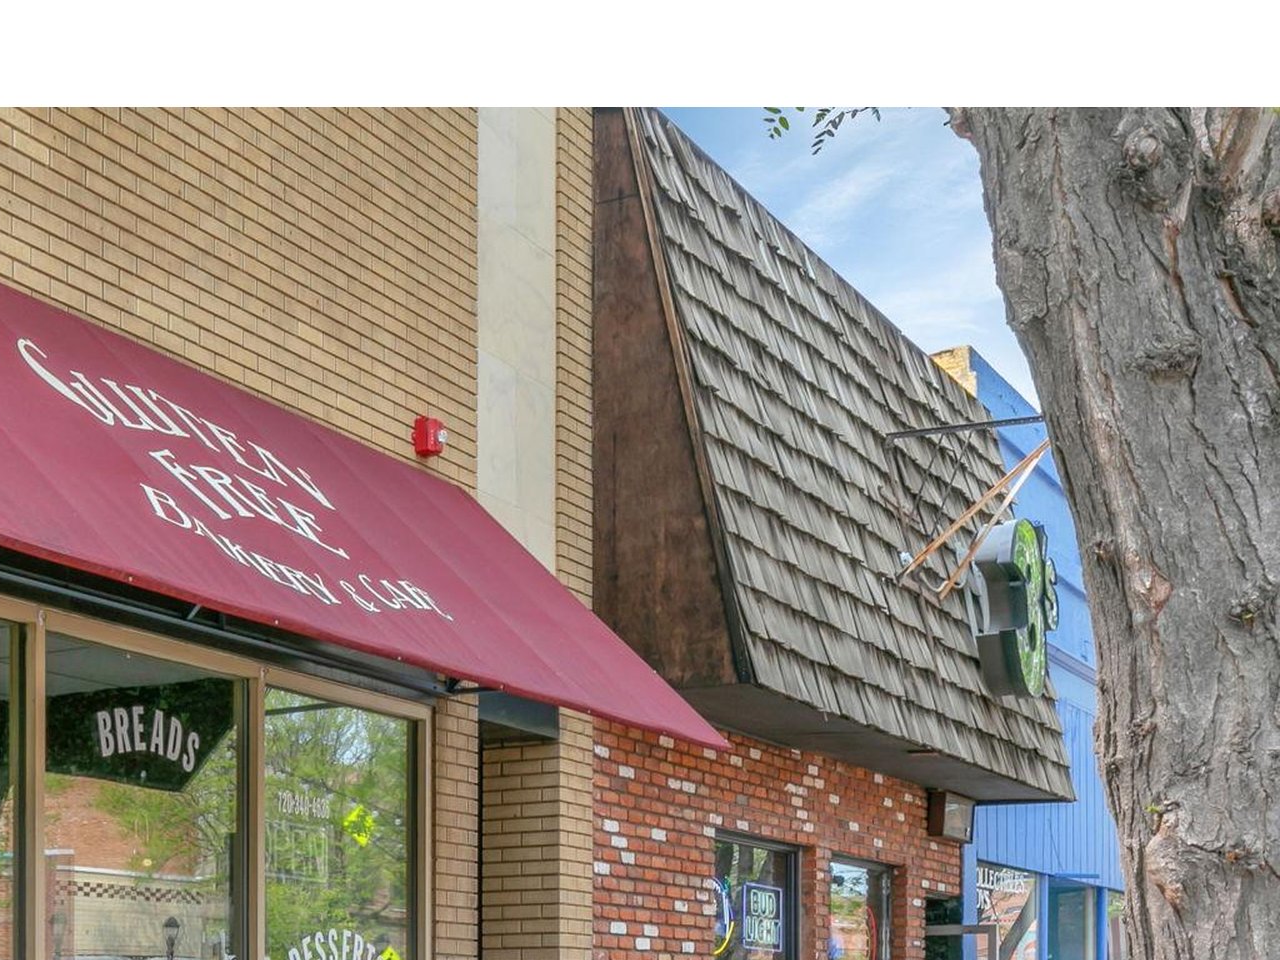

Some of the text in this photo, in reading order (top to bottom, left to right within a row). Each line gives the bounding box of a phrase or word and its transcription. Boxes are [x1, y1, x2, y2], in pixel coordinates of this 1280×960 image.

[17, 338, 336, 510] GLUTEN
[139, 483, 342, 605] BAKERY
[340, 580, 381, 613] &
[149, 449, 351, 560] FREE
[97, 705, 200, 773] BREADS
[745, 916, 780, 945] LIGHT
[751, 889, 776, 918] BUD
